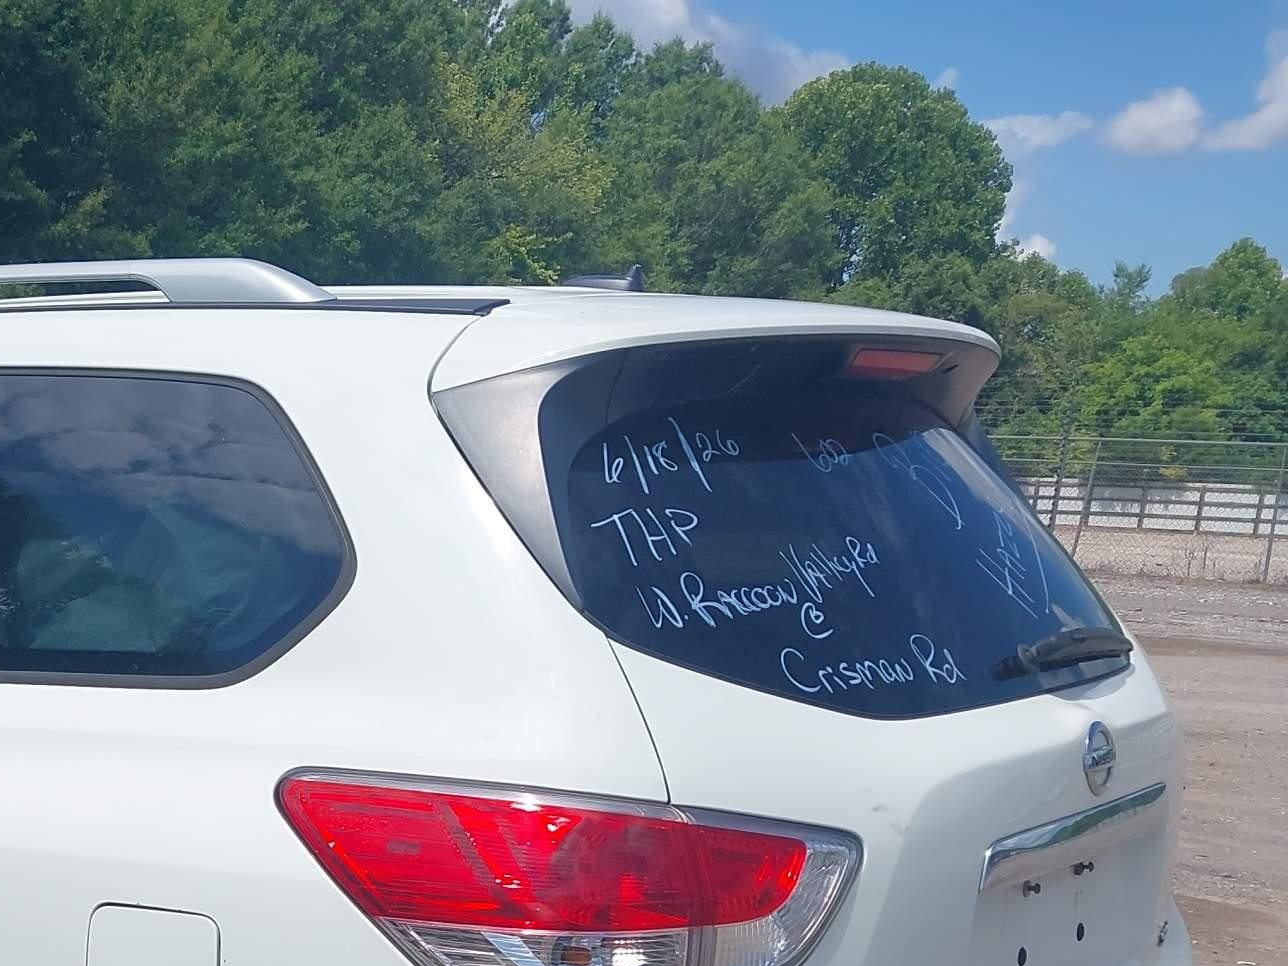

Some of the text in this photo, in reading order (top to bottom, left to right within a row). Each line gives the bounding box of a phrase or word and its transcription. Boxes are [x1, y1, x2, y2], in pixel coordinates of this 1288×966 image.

[602, 416, 741, 495] 6/18/26
[591, 508, 699, 568] THP
[910, 633, 966, 685] Rd
